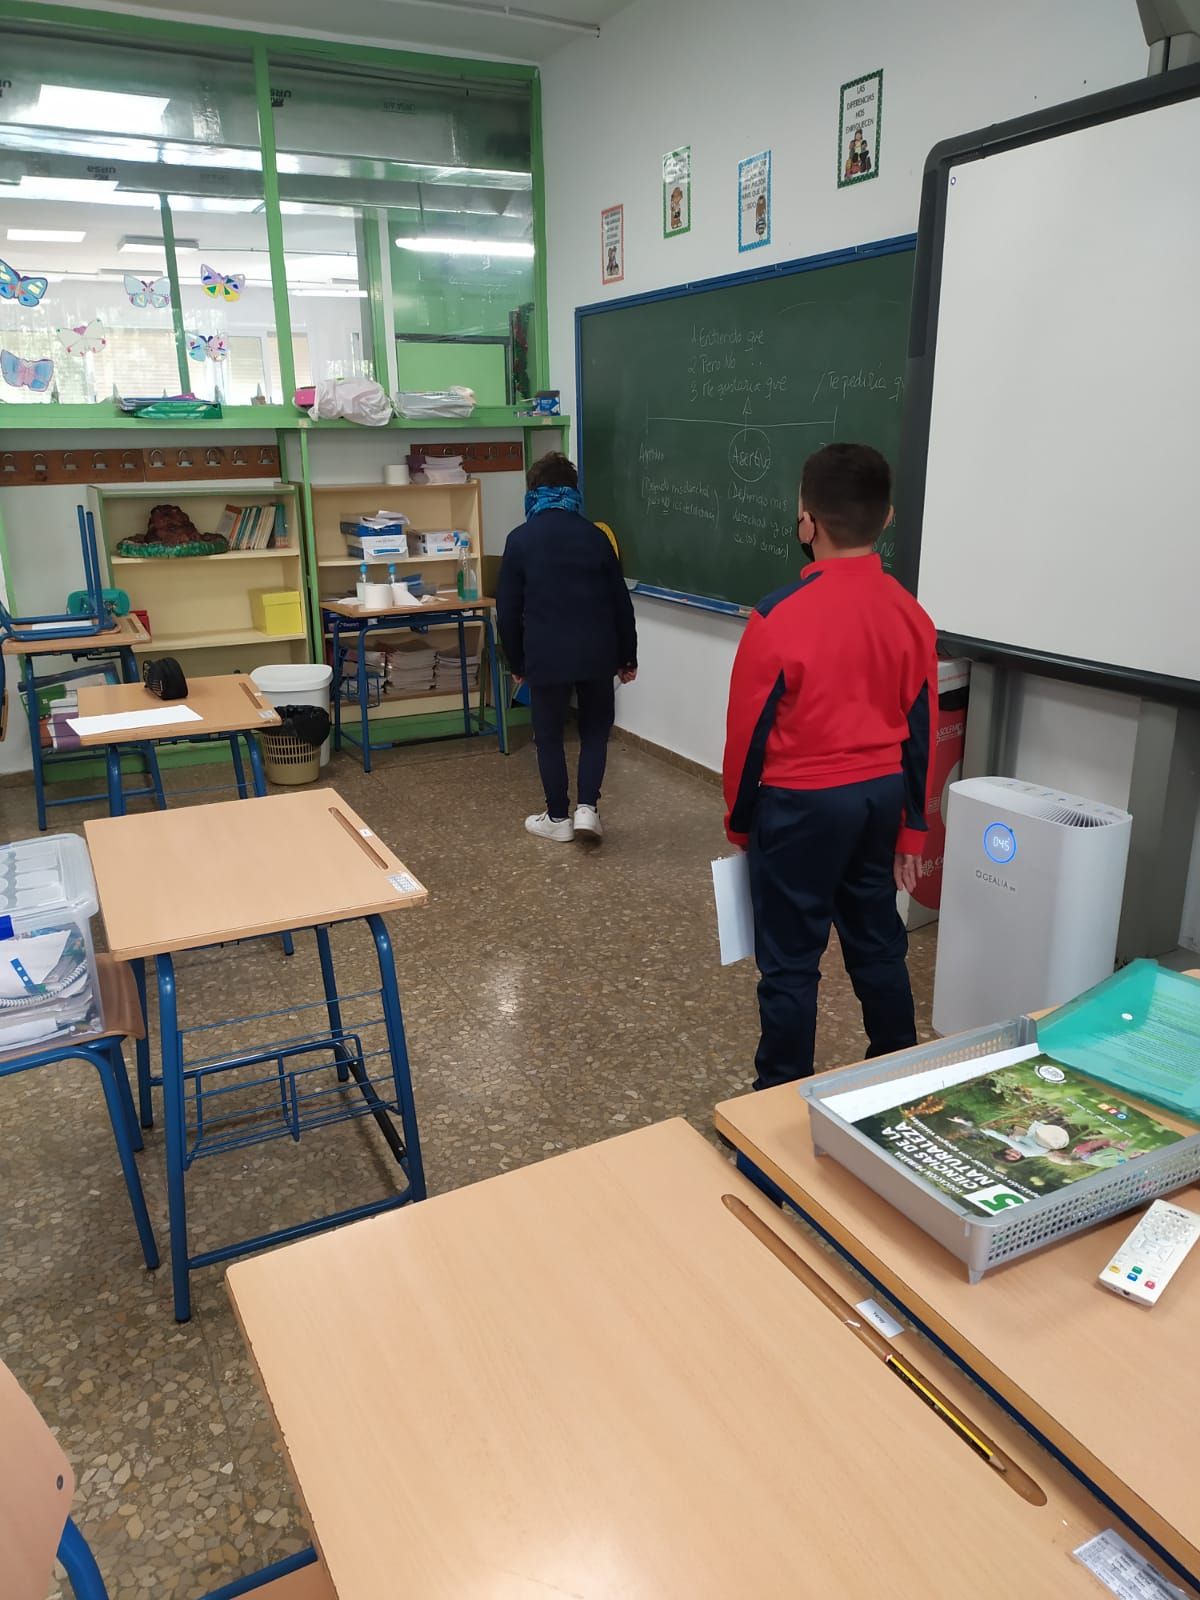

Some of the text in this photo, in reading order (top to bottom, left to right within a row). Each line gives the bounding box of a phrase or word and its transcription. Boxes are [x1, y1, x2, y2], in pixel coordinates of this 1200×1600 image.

[856, 84, 866, 94] LAS
[846, 92, 875, 110] DIFERENCIAS
[855, 108, 865, 119] NOS
[993, 836, 1010, 852] 045
[880, 1126, 979, 1190] CIENCIAS DE LA
[893, 1121, 994, 1186] NATURALEZA
[980, 1192, 1025, 1213] 5
